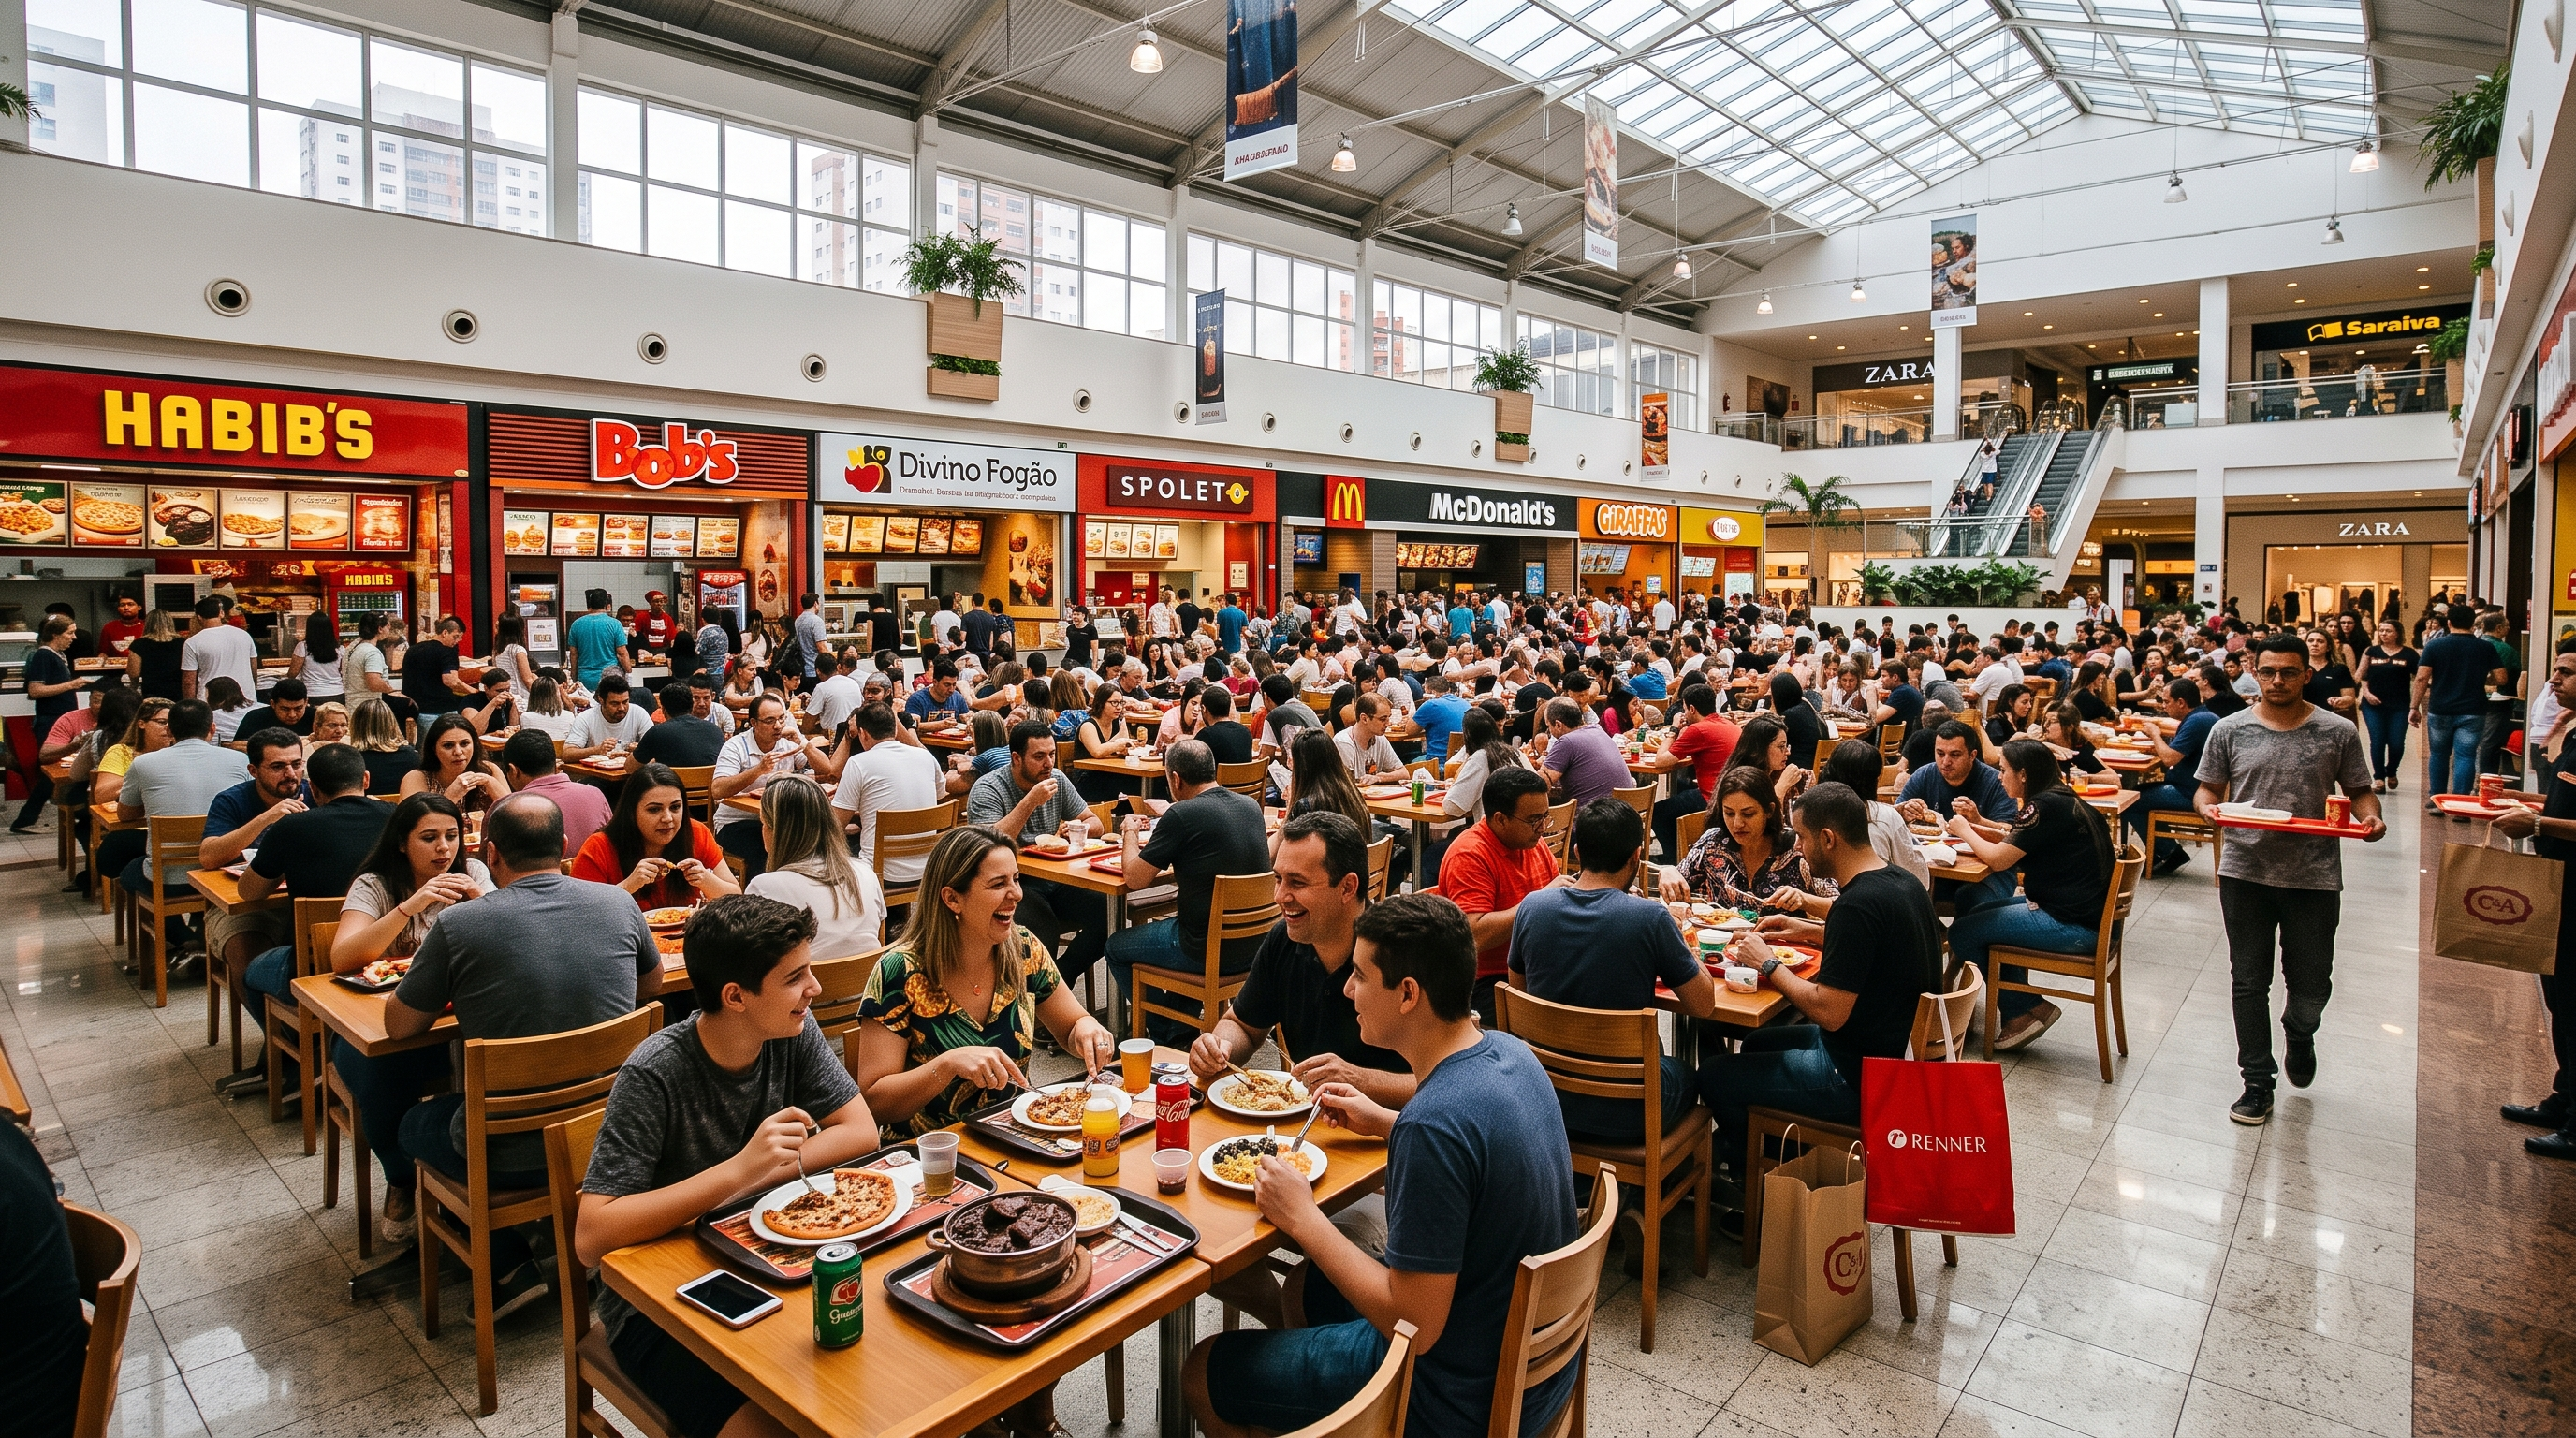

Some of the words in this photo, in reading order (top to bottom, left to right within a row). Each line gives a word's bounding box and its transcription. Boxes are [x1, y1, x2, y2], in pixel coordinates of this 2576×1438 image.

[2346, 315, 2441, 336] Saraiva
[1865, 360, 1935, 384] ZARA
[104, 389, 373, 460] HABIB'S
[591, 418, 739, 489] Bob's
[899, 451, 981, 482] Divino
[986, 458, 1058, 492] Fogão
[1428, 492, 1556, 526] McDonald's
[2339, 521, 2410, 536] ZARA
[2477, 894, 2517, 915] C&A
[1911, 1133, 1987, 1153] RENNER
